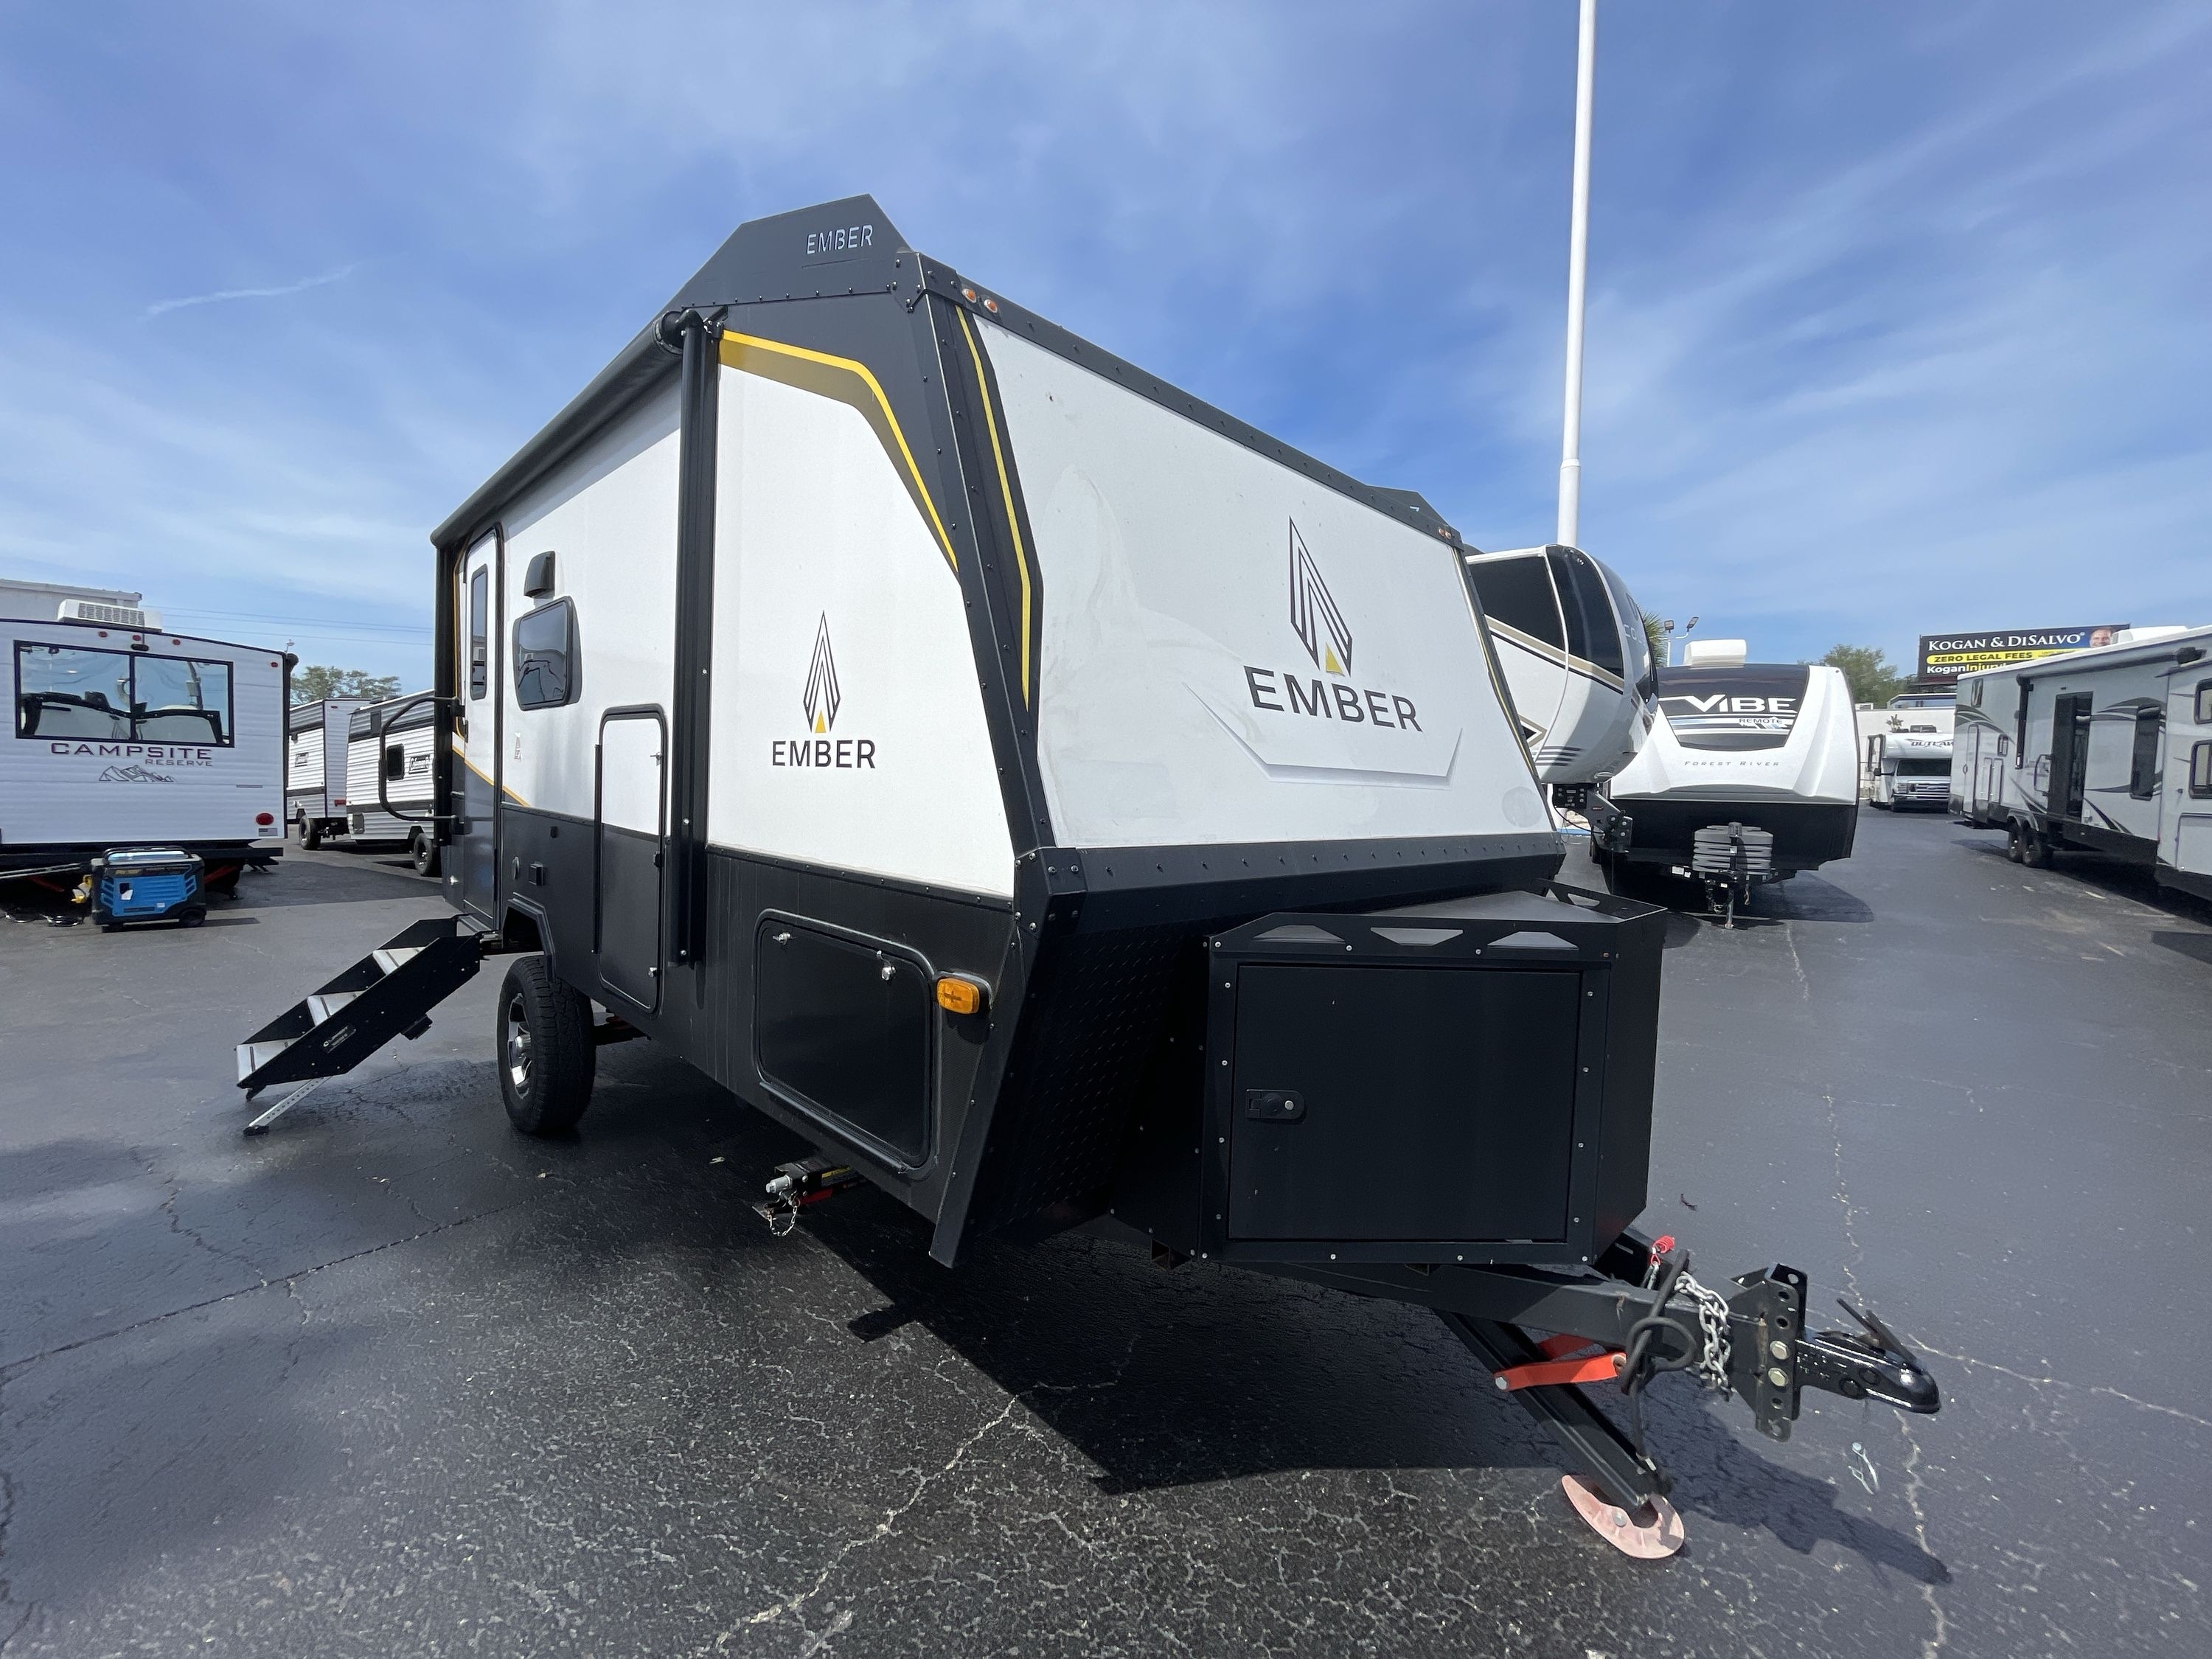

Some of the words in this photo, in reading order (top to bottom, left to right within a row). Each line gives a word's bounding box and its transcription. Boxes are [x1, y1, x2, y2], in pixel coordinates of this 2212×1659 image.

[807, 224, 873, 254] EMBER
[1928, 639, 1986, 651] KOGAN
[1989, 636, 2005, 648] &
[1934, 655, 1963, 663] ZERO
[1966, 653, 2001, 661] LEGAL
[2005, 652, 2033, 660] FEES
[1243, 665, 1423, 733] EMBER
[1659, 694, 1798, 713] VIBE
[51, 742, 212, 759] CAMPSITE
[772, 740, 876, 768] EMBER
[145, 759, 213, 767] RESERVE
